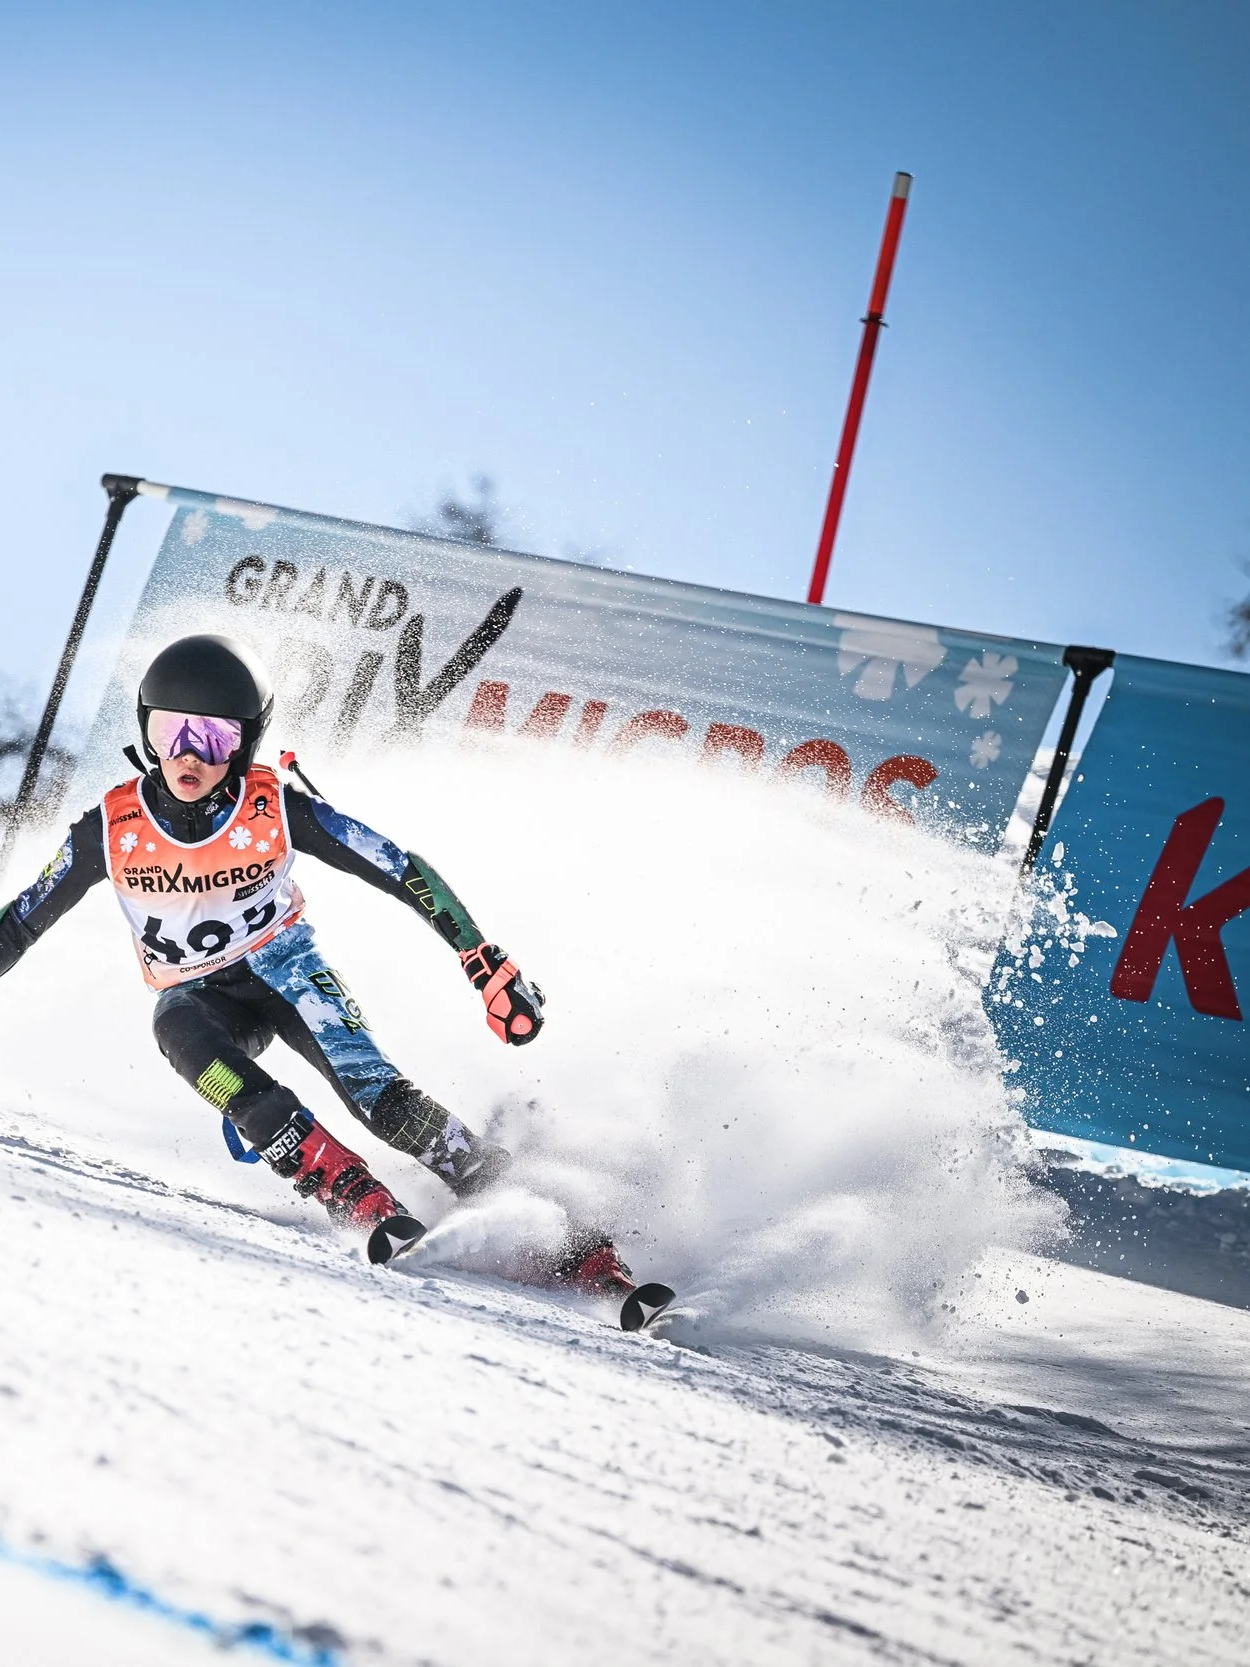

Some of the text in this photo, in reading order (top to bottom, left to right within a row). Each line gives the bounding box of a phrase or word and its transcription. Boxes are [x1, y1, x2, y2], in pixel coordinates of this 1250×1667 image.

[224, 555, 409, 632] GRAND
[124, 865, 162, 876] GRAND
[1109, 796, 1250, 1021] K
